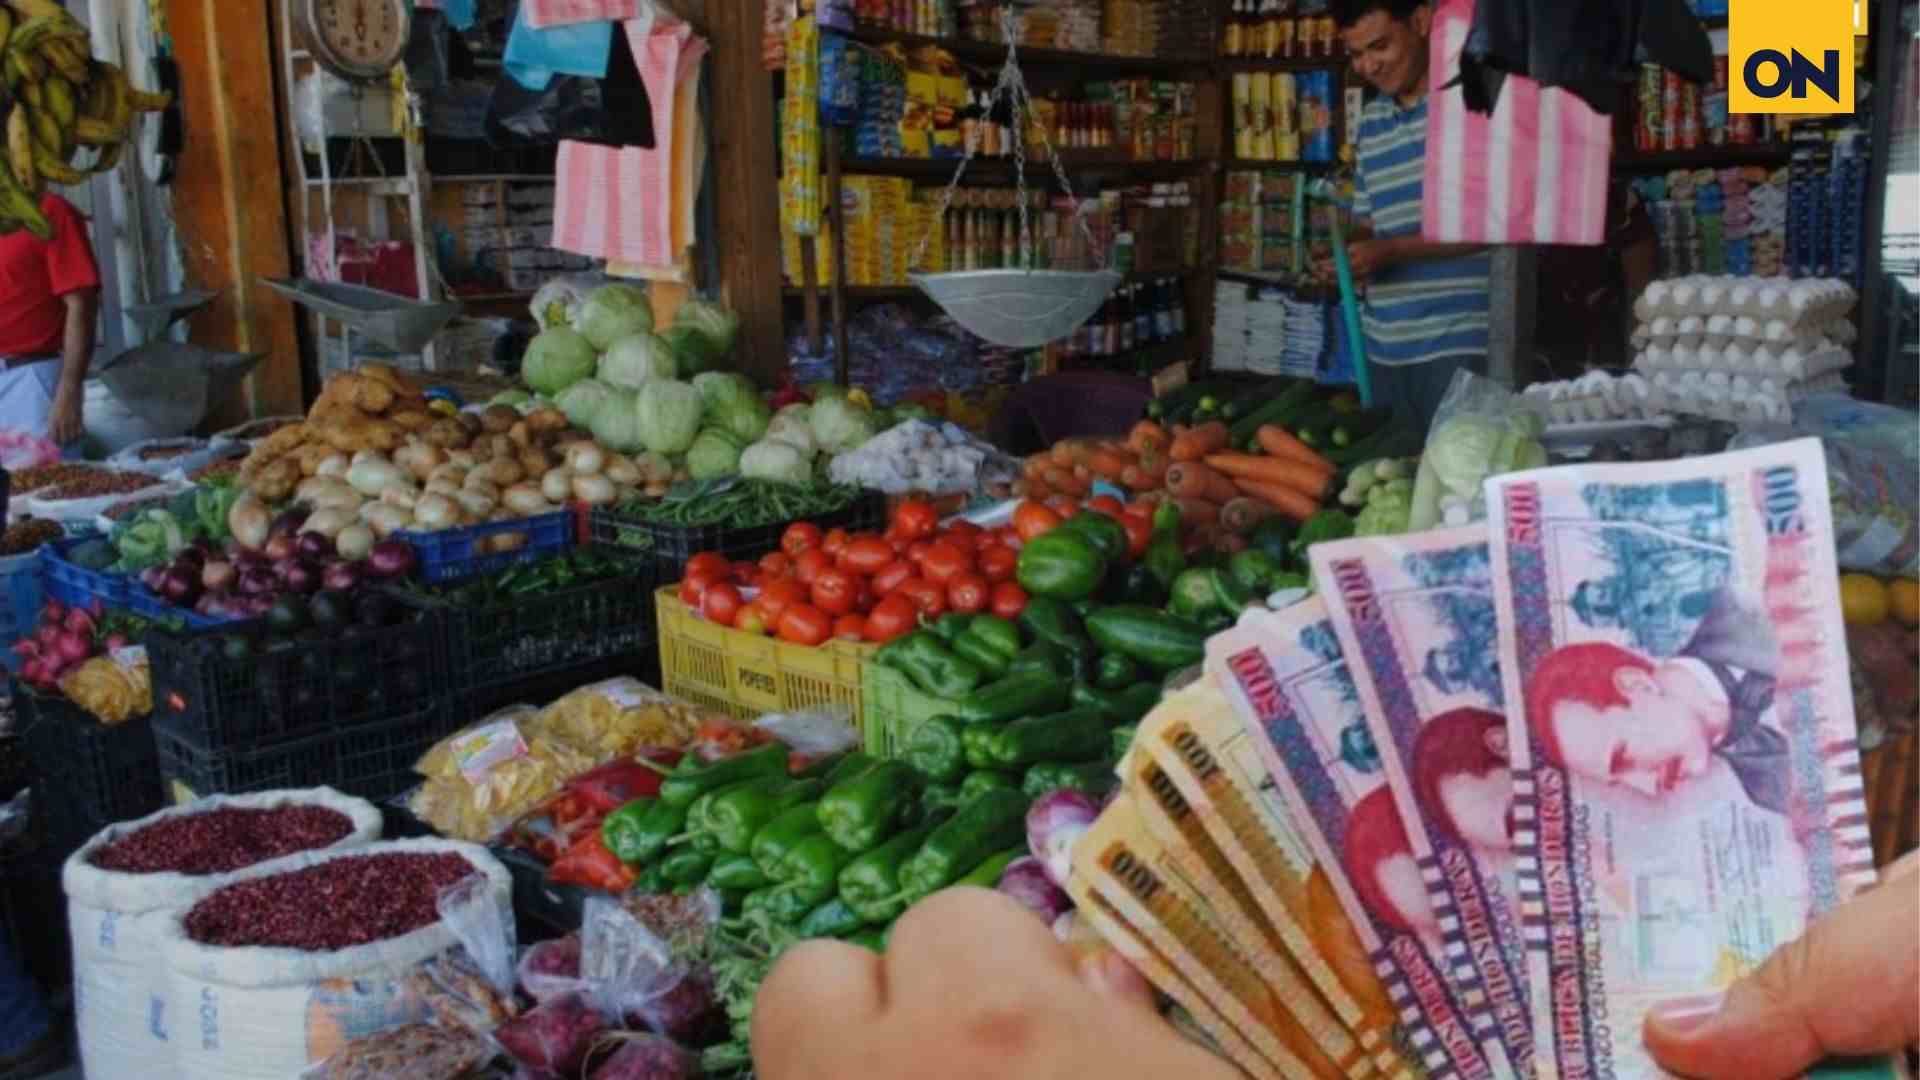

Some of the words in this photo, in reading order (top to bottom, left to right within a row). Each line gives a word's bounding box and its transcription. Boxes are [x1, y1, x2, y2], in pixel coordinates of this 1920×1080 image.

[1503, 482, 1543, 544] 500
[1762, 465, 1804, 535] 500
[1330, 557, 1383, 621] 500
[1229, 646, 1292, 720] 500
